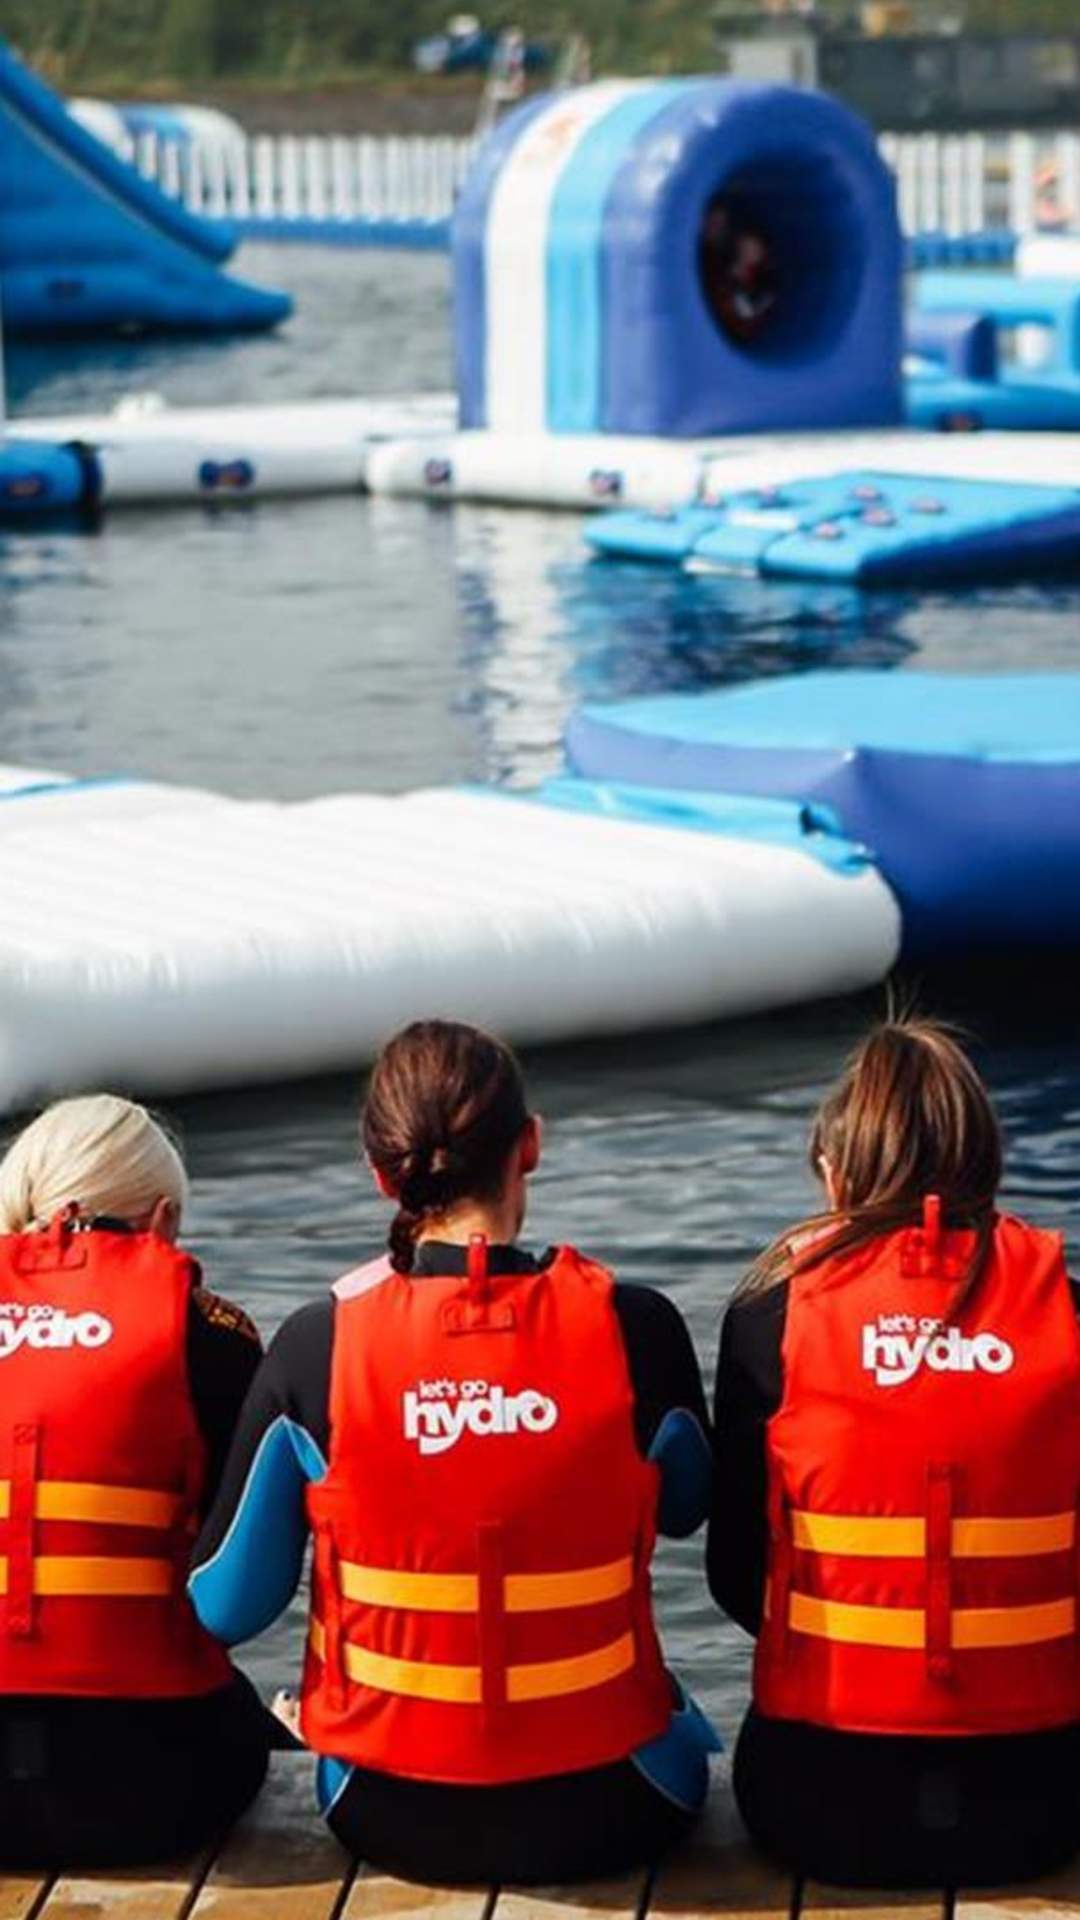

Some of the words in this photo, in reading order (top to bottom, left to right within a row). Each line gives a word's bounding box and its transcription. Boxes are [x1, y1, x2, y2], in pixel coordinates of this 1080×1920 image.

[27, 1304, 55, 1321] go
[877, 1313, 917, 1333] let's
[0, 1308, 113, 1359] ydro
[863, 1323, 1014, 1387] hydro
[419, 1378, 458, 1399] let's
[460, 1379, 488, 1400] go
[404, 1385, 558, 1456] hydro
